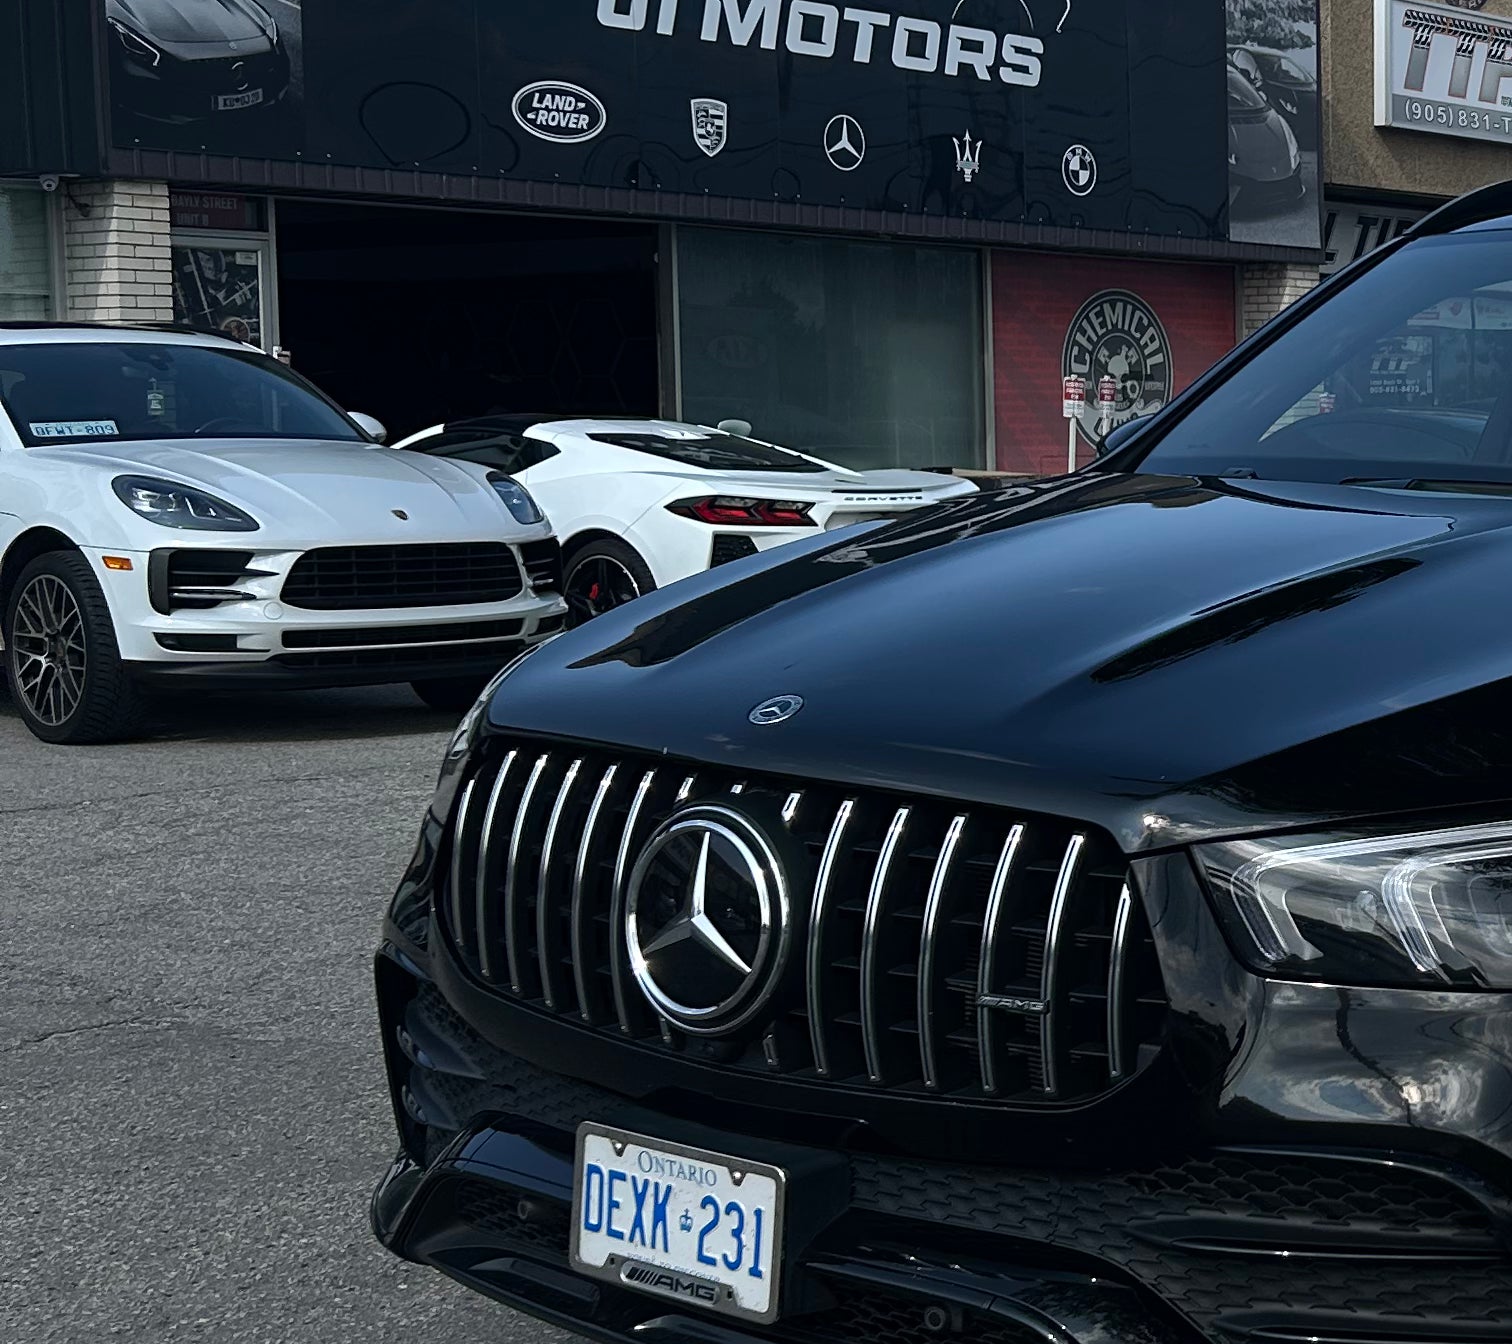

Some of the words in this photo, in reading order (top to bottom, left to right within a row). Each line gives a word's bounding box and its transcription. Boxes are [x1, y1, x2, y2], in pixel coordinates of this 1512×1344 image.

[532, 92, 576, 111] LAND
[1405, 98, 1454, 127] (905)
[536, 109, 590, 130] ROVER
[202, 196, 238, 210] STREET
[1071, 301, 1164, 375] CHEMICAL
[584, 1163, 673, 1253] DEXK
[697, 1194, 764, 1280] 231
[654, 1273, 715, 1302] AMG
